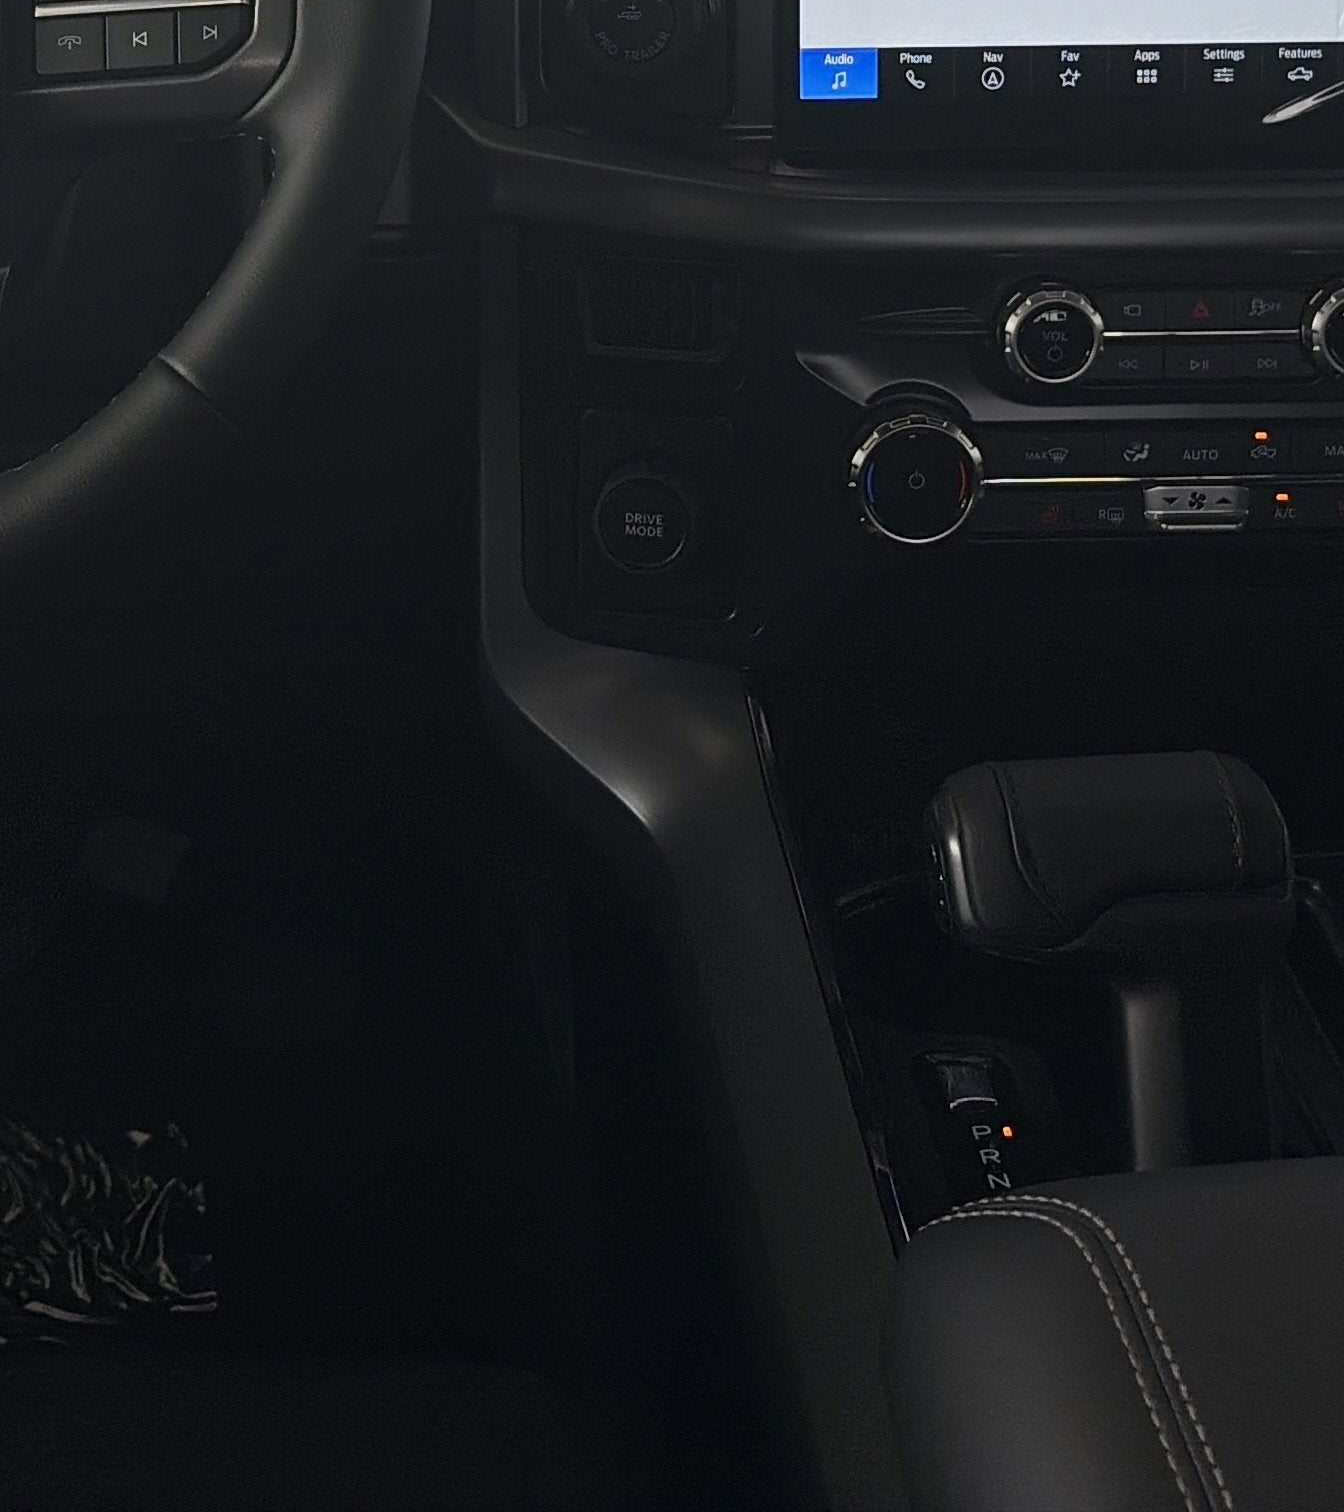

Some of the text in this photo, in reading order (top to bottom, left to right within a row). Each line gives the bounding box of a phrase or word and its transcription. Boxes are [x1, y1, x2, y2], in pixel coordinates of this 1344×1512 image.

[824, 53, 854, 65] Audio
[899, 52, 933, 64] Phone
[983, 51, 1003, 63] Nav
[1060, 50, 1080, 62] Fav
[1133, 49, 1160, 63] Apps
[1203, 48, 1245, 61] Settings
[1278, 47, 1323, 59] Features
[1042, 331, 1068, 342] VOL
[1183, 449, 1219, 460] AUTO
[624, 512, 665, 525] DRIVE
[1274, 507, 1297, 518] A/C
[624, 525, 664, 537] MODE
[971, 1124, 991, 1140] P
[979, 1148, 1001, 1165] R
[987, 1171, 1012, 1189] N
